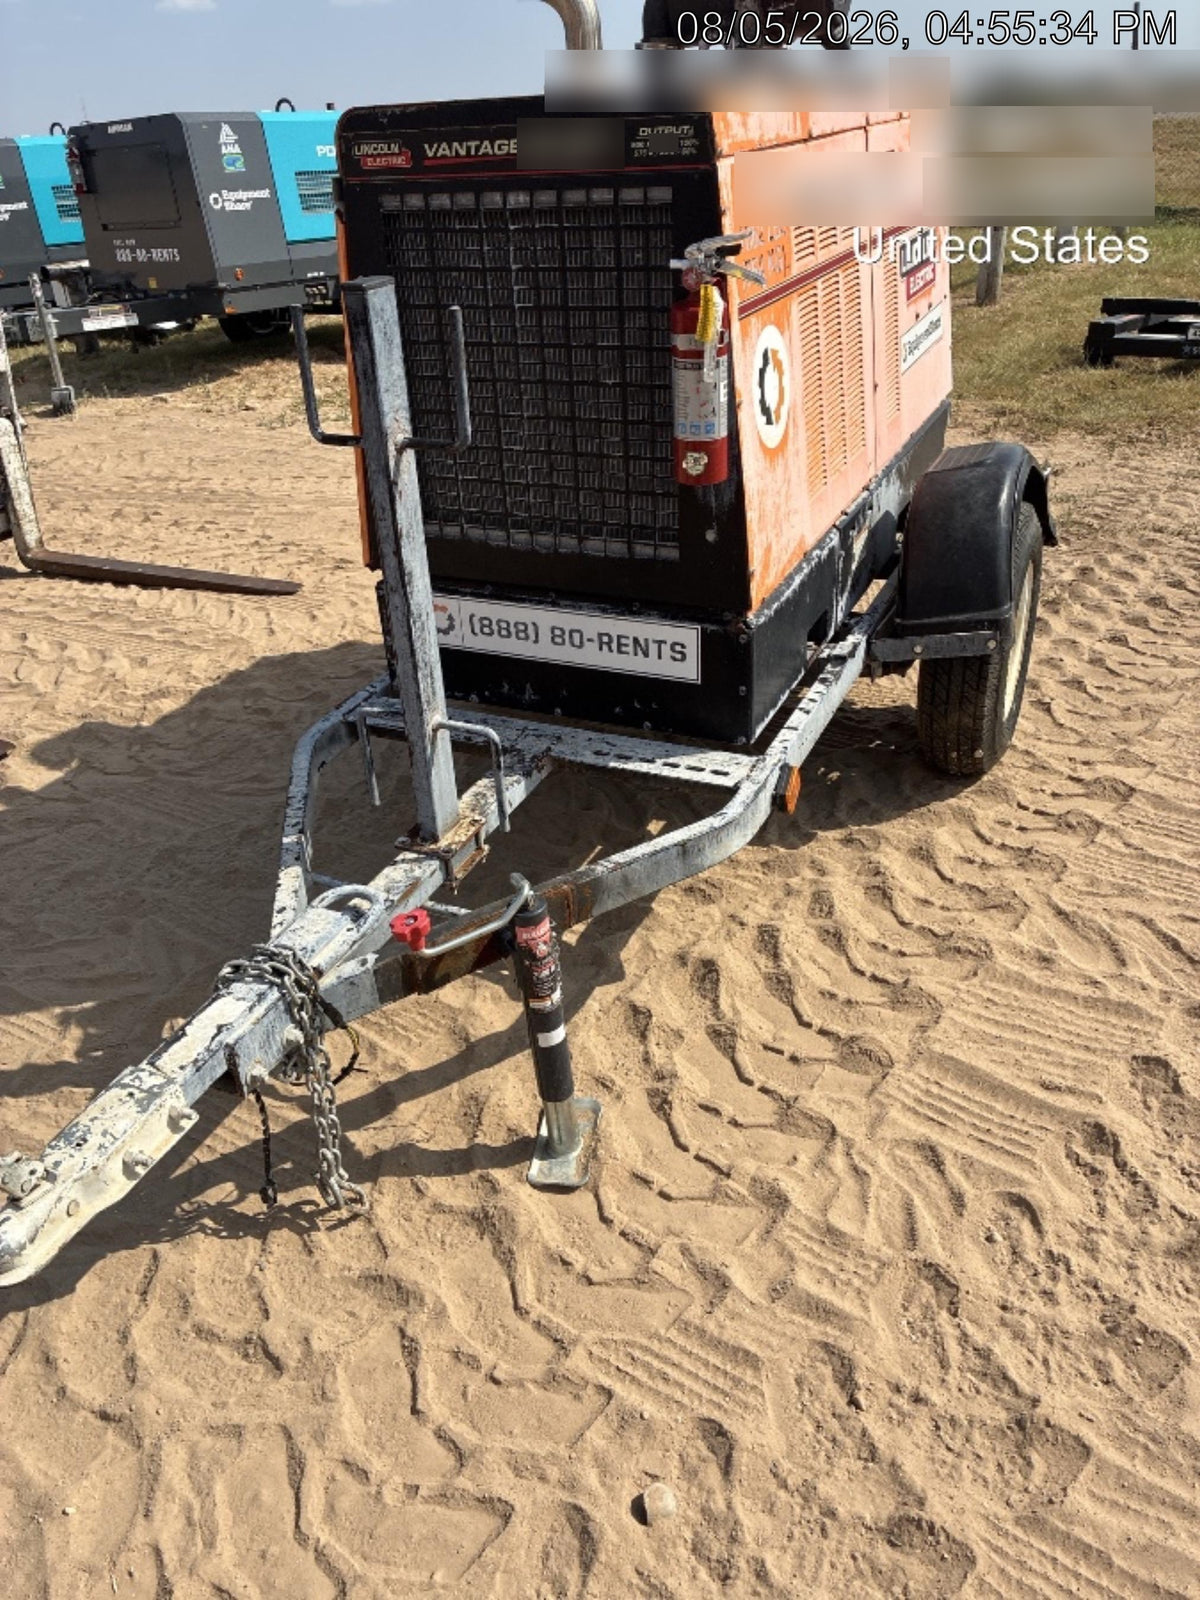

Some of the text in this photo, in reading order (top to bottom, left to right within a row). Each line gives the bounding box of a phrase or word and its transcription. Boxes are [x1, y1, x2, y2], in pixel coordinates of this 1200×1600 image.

[316, 145, 336, 158] PD
[354, 143, 400, 156] LINCOLN
[424, 138, 518, 158] VANTAGE
[366, 156, 406, 167] ELECTRIC
[221, 188, 271, 202] Equipment
[468, 613, 688, 663] (888) 80-RENTS
